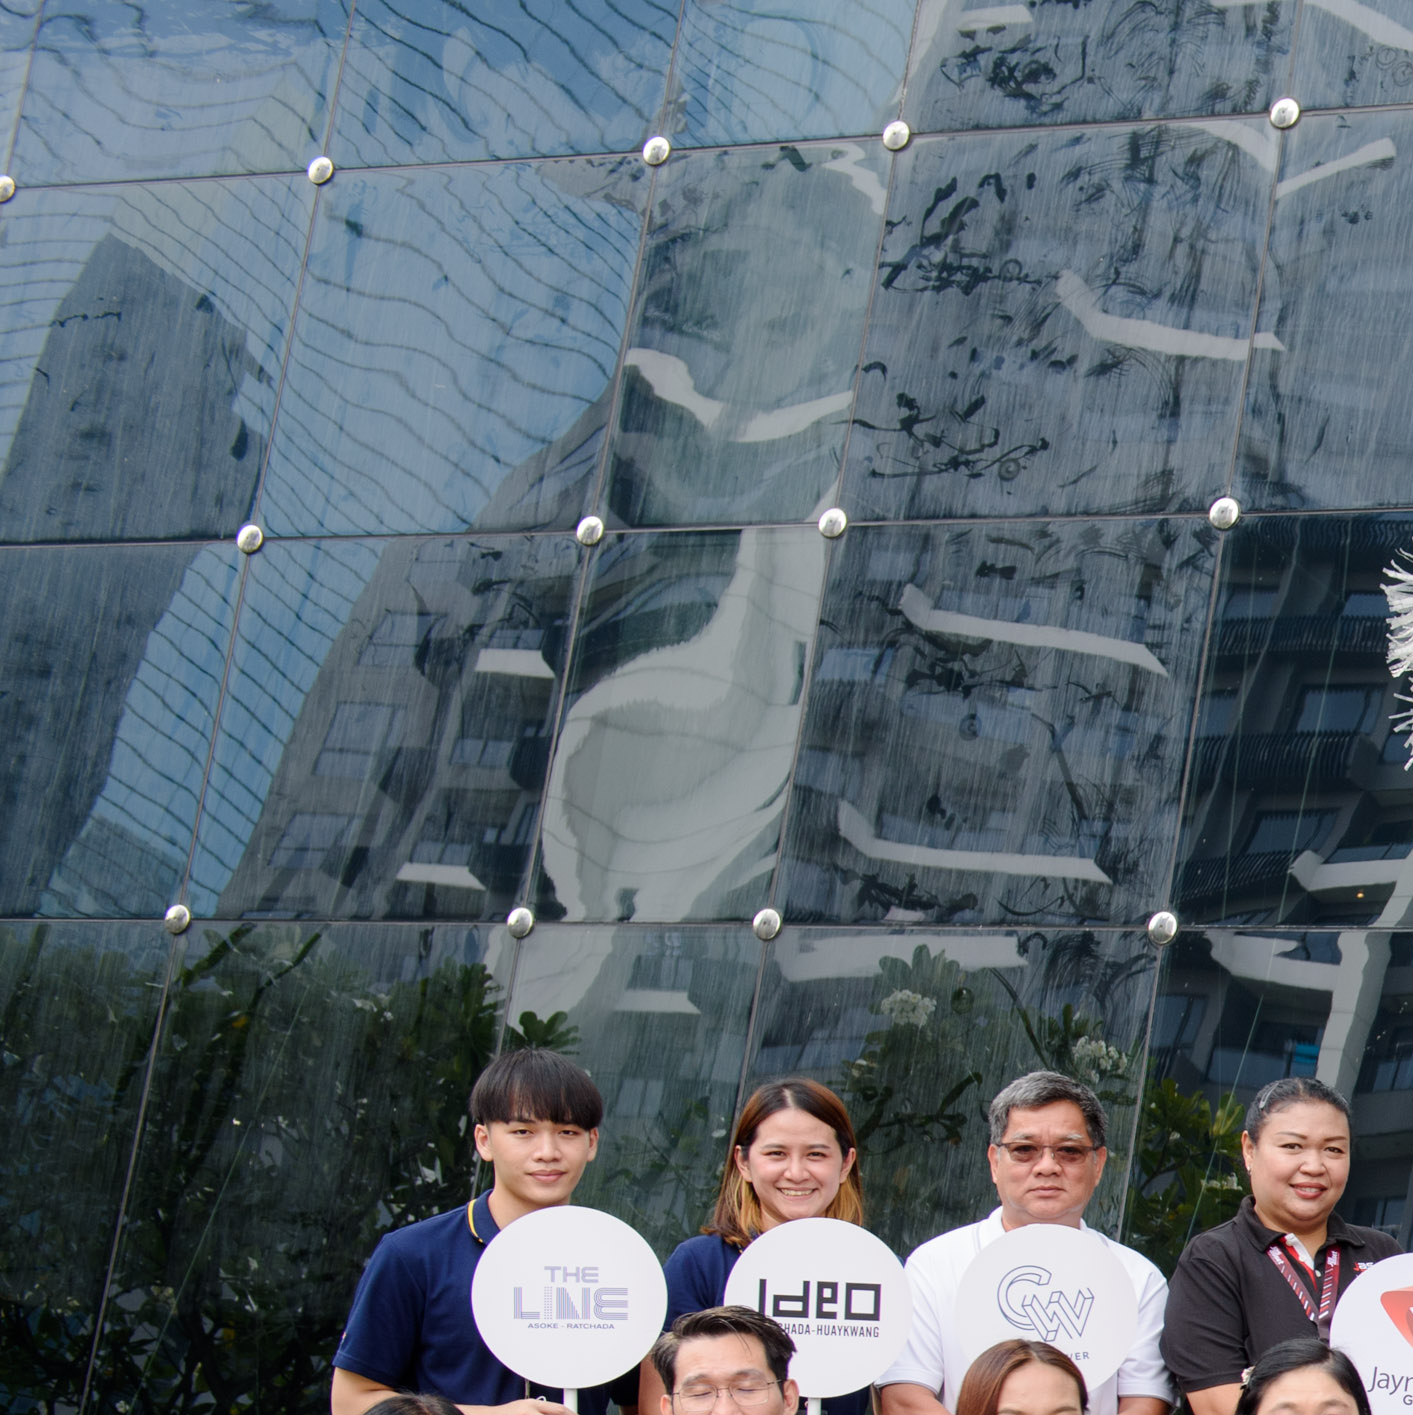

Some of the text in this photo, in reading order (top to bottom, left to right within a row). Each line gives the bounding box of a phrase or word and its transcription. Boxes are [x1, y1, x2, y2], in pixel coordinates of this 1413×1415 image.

[544, 1265, 599, 1284] THE
[513, 1286, 629, 1321] LINE
[527, 1322, 559, 1330] ASOKE
[566, 1322, 616, 1330] RATCHADA
